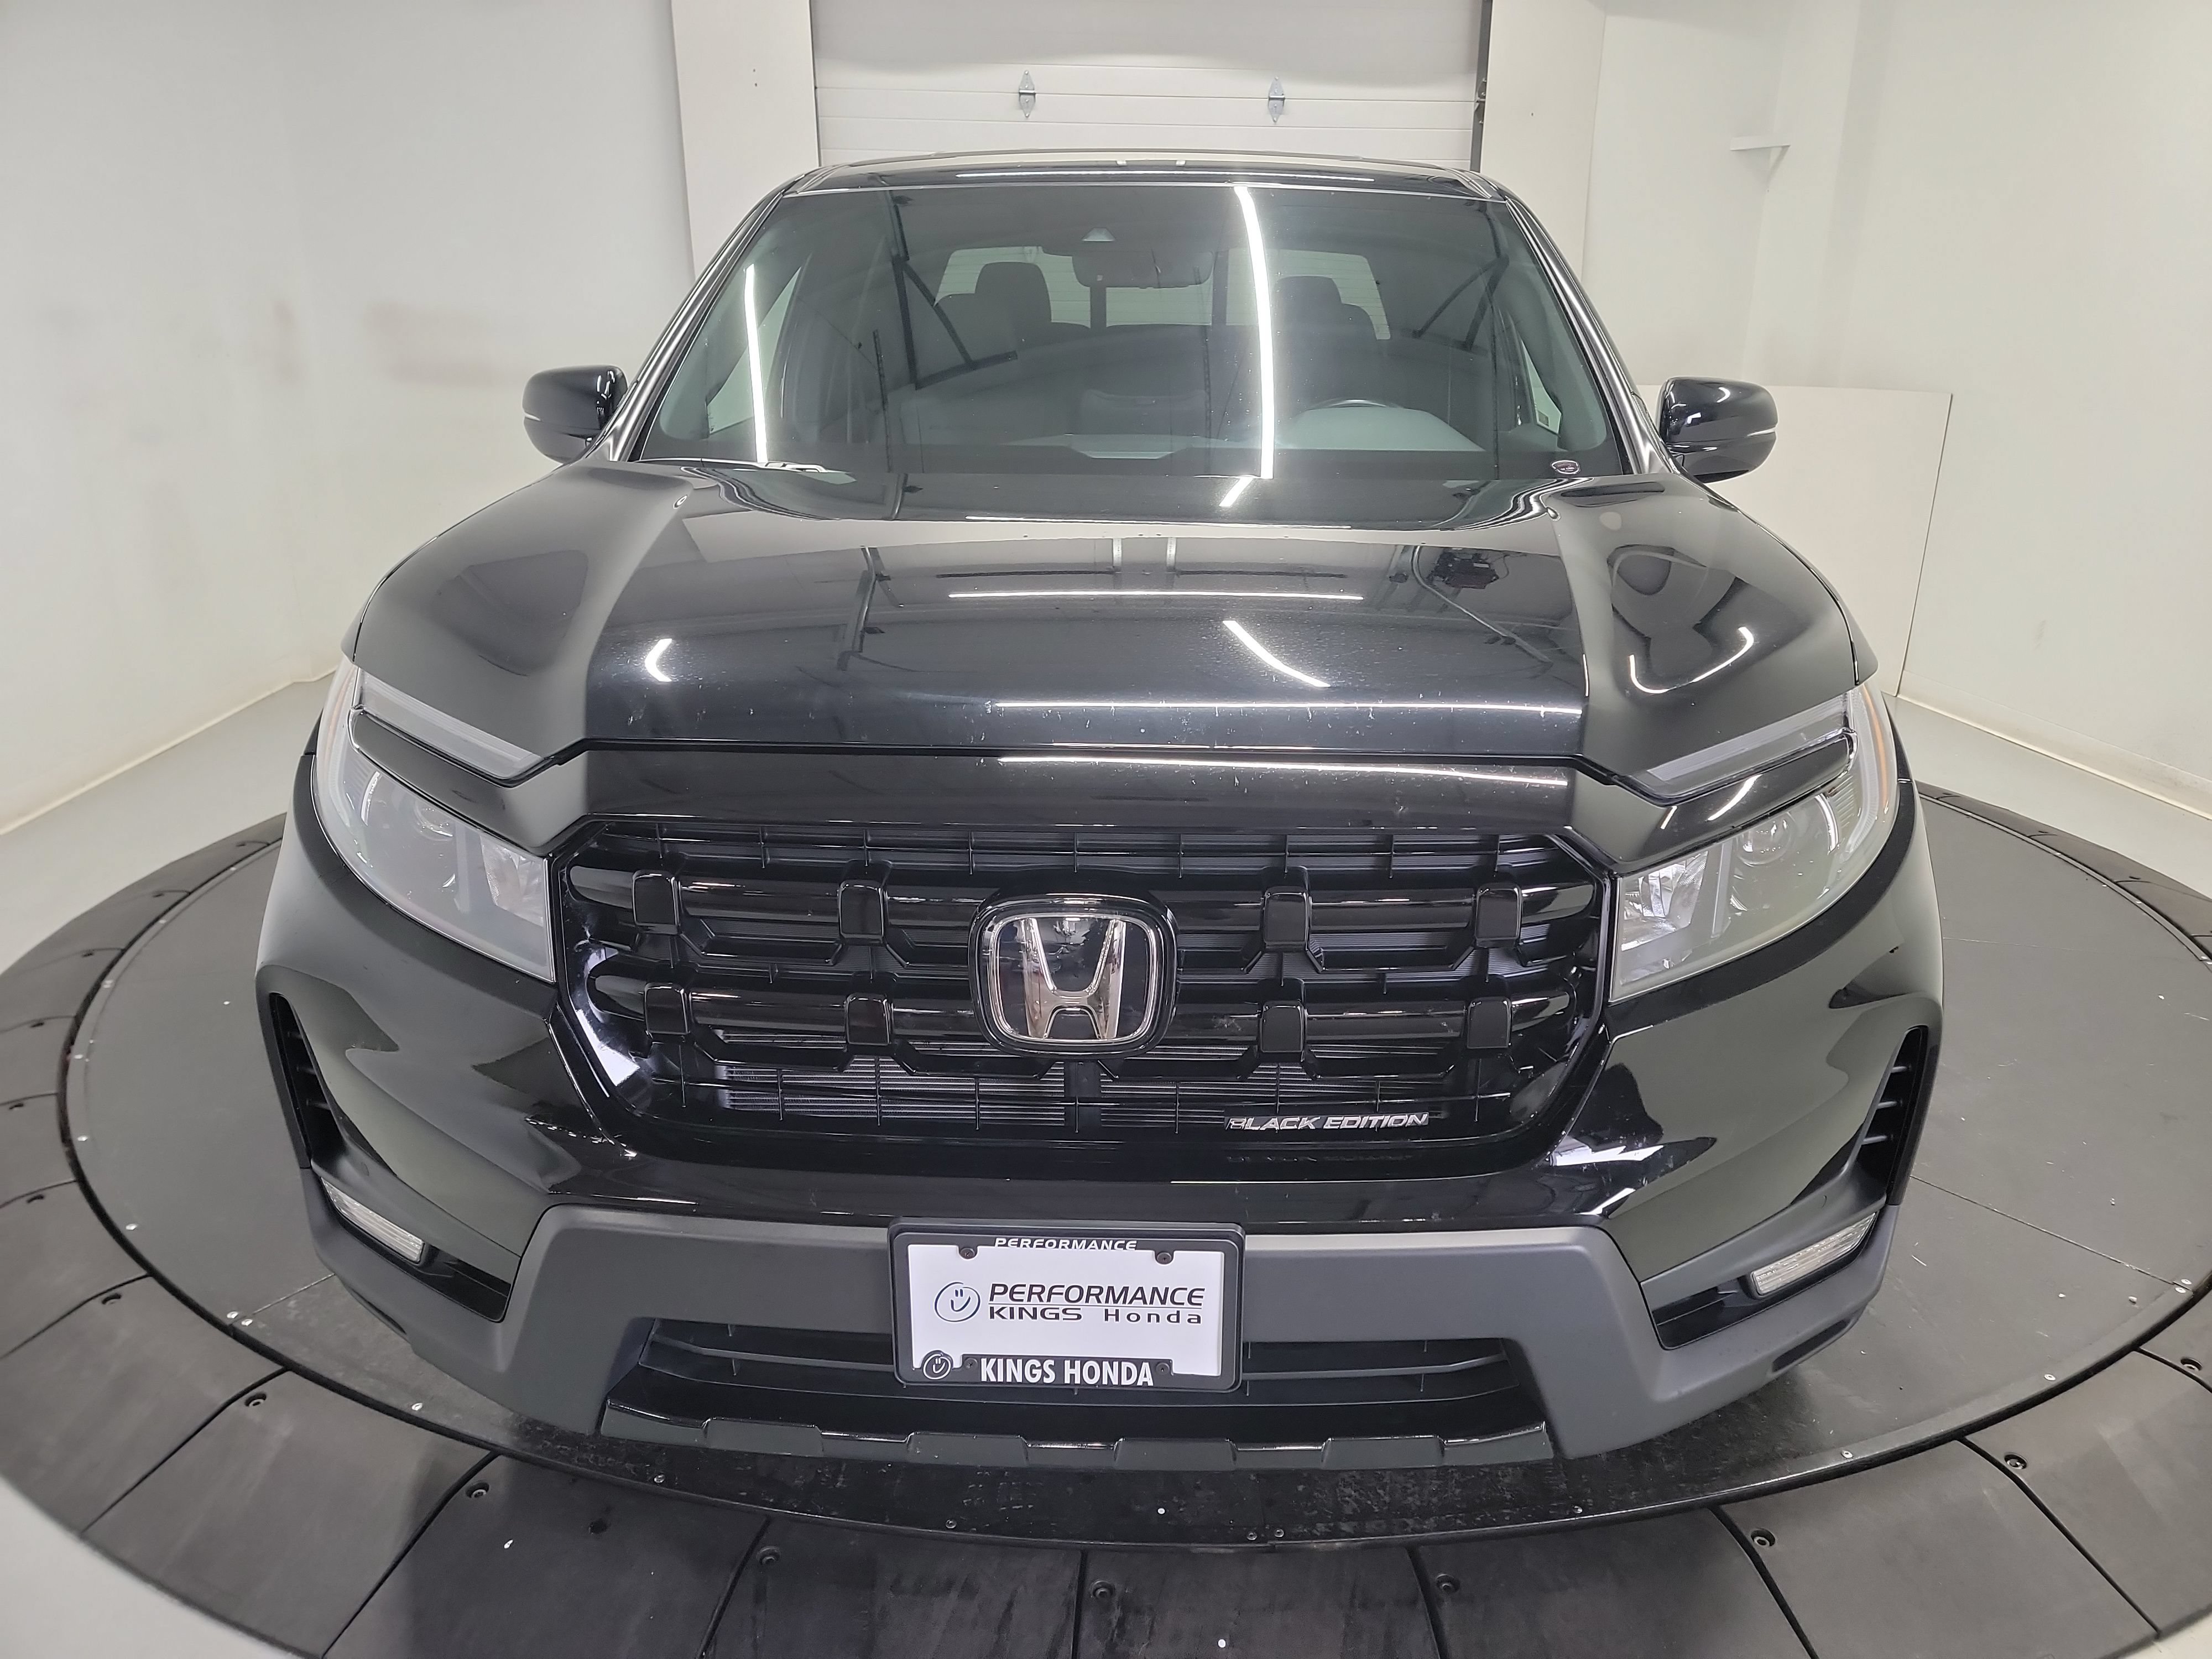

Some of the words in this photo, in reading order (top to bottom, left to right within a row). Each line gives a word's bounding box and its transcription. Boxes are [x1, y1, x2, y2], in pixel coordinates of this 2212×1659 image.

[1226, 1116, 1321, 1130] BLACK
[1323, 1113, 1428, 1129] EDITION
[995, 1238, 1137, 1251] PERFORMANCE
[989, 1284, 1205, 1306] PERFORMANCE
[989, 1307, 1082, 1321] KINGS
[1105, 1309, 1202, 1324] Honda
[980, 1358, 1056, 1384] KINGS
[1064, 1359, 1154, 1386] HONDA
